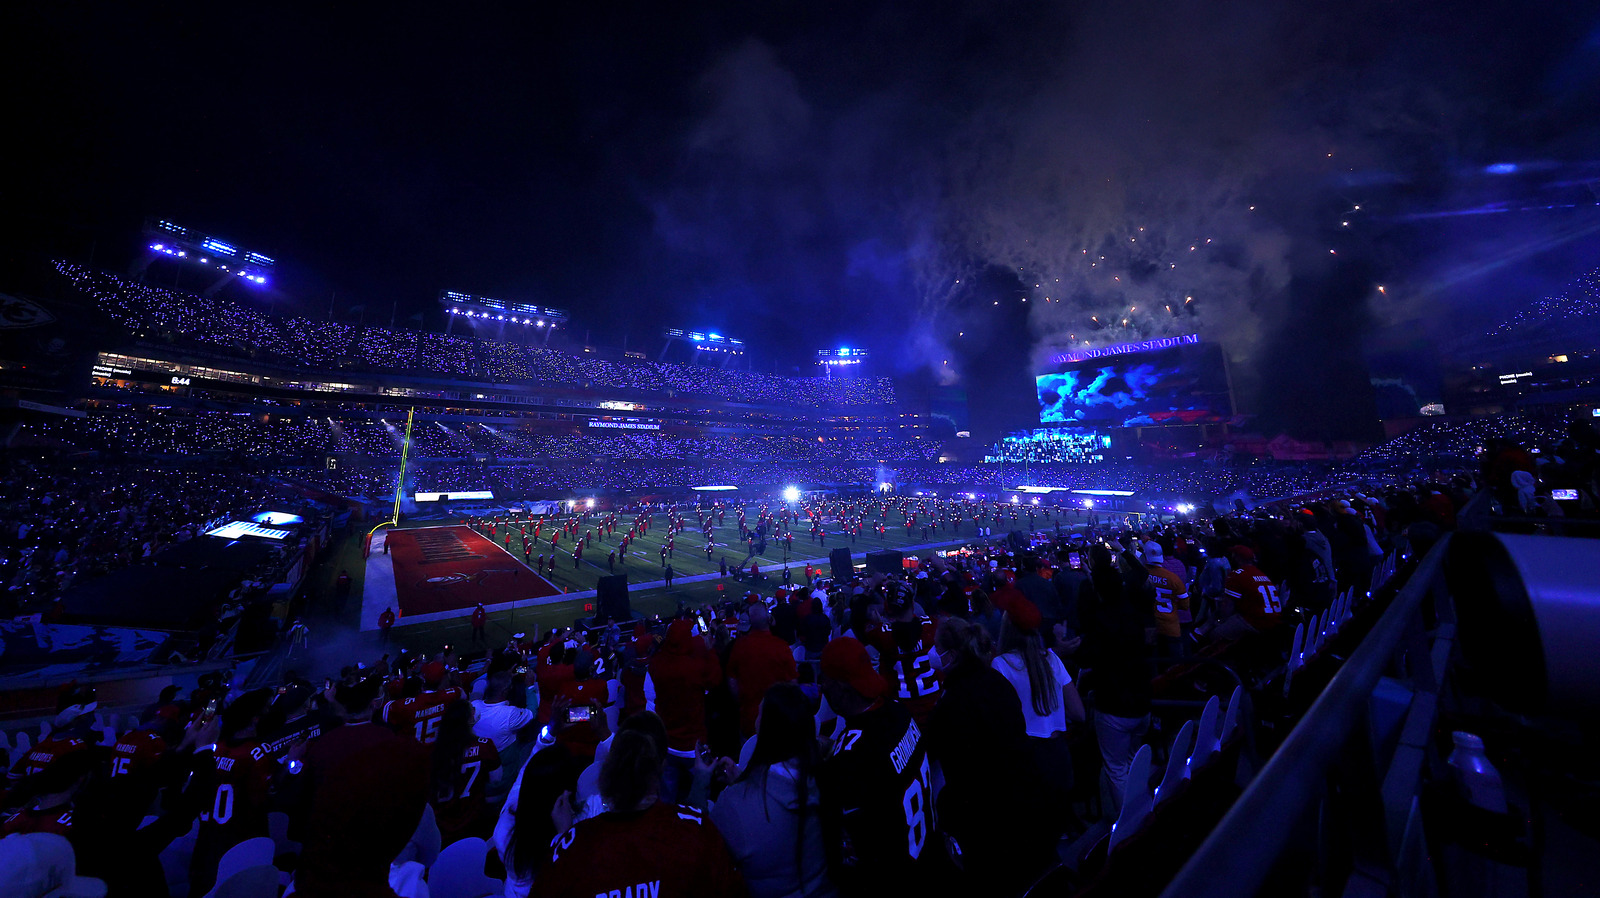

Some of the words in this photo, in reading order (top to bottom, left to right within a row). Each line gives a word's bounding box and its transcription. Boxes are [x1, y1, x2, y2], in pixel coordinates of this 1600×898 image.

[1102, 343, 1140, 357] JAMES
[1142, 333, 1199, 351] STADIUM
[589, 421, 618, 429] RAYMOND
[618, 422, 637, 430] JAMES
[636, 423, 660, 431] STADIUM
[1257, 585, 1282, 614] 15
[893, 654, 940, 698] 12
[414, 716, 442, 743] 15
[595, 880, 660, 898] ADY
